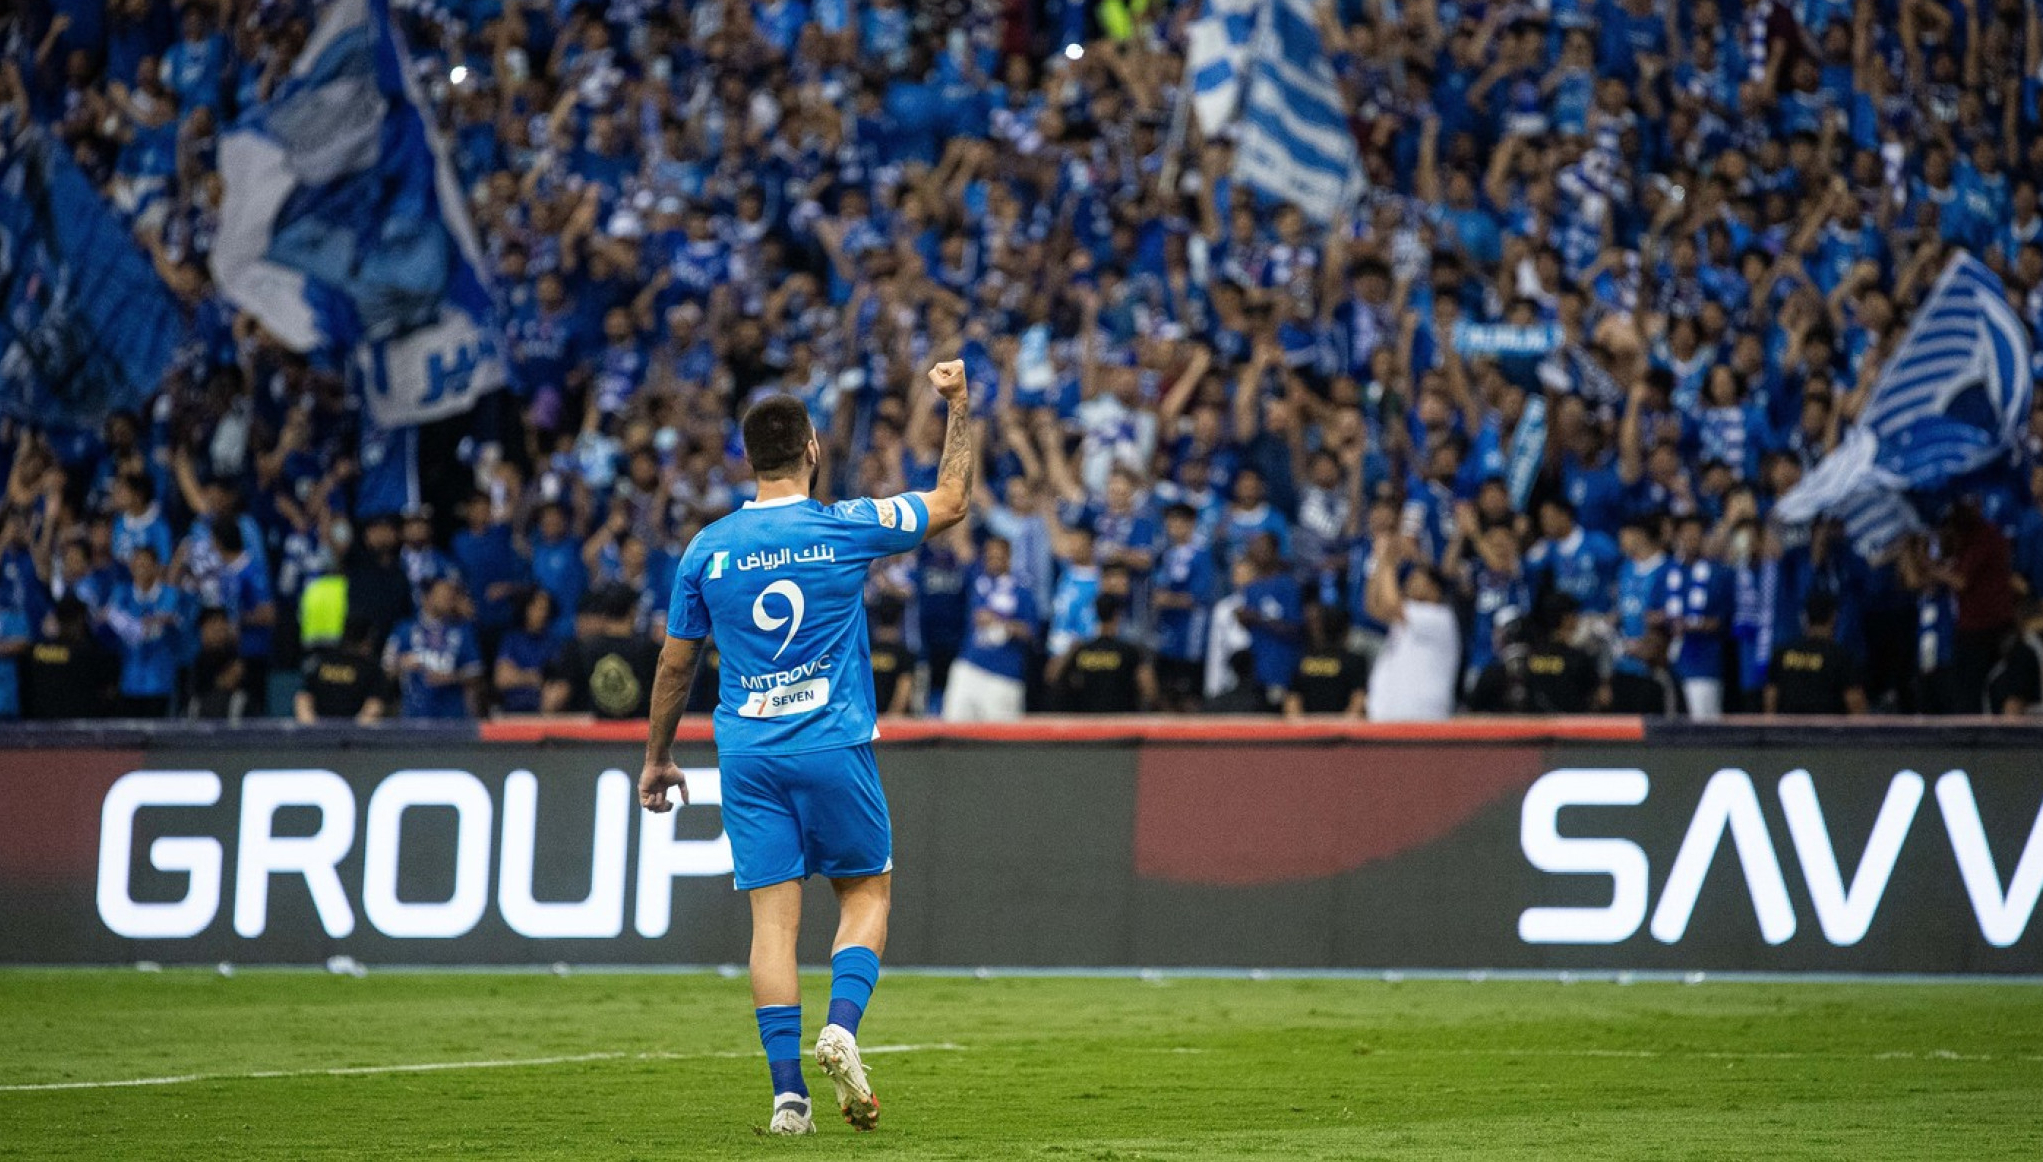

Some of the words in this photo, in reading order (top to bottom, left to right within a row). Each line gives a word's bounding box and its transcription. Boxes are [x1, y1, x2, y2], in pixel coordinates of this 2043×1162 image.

[736, 547, 791, 571] الرياض
[793, 543, 836, 563] بنك
[752, 579, 804, 661] 9
[772, 690, 815, 707] SEVEN
[96, 769, 734, 938] GROUP
[1517, 767, 2043, 947] SAVV
